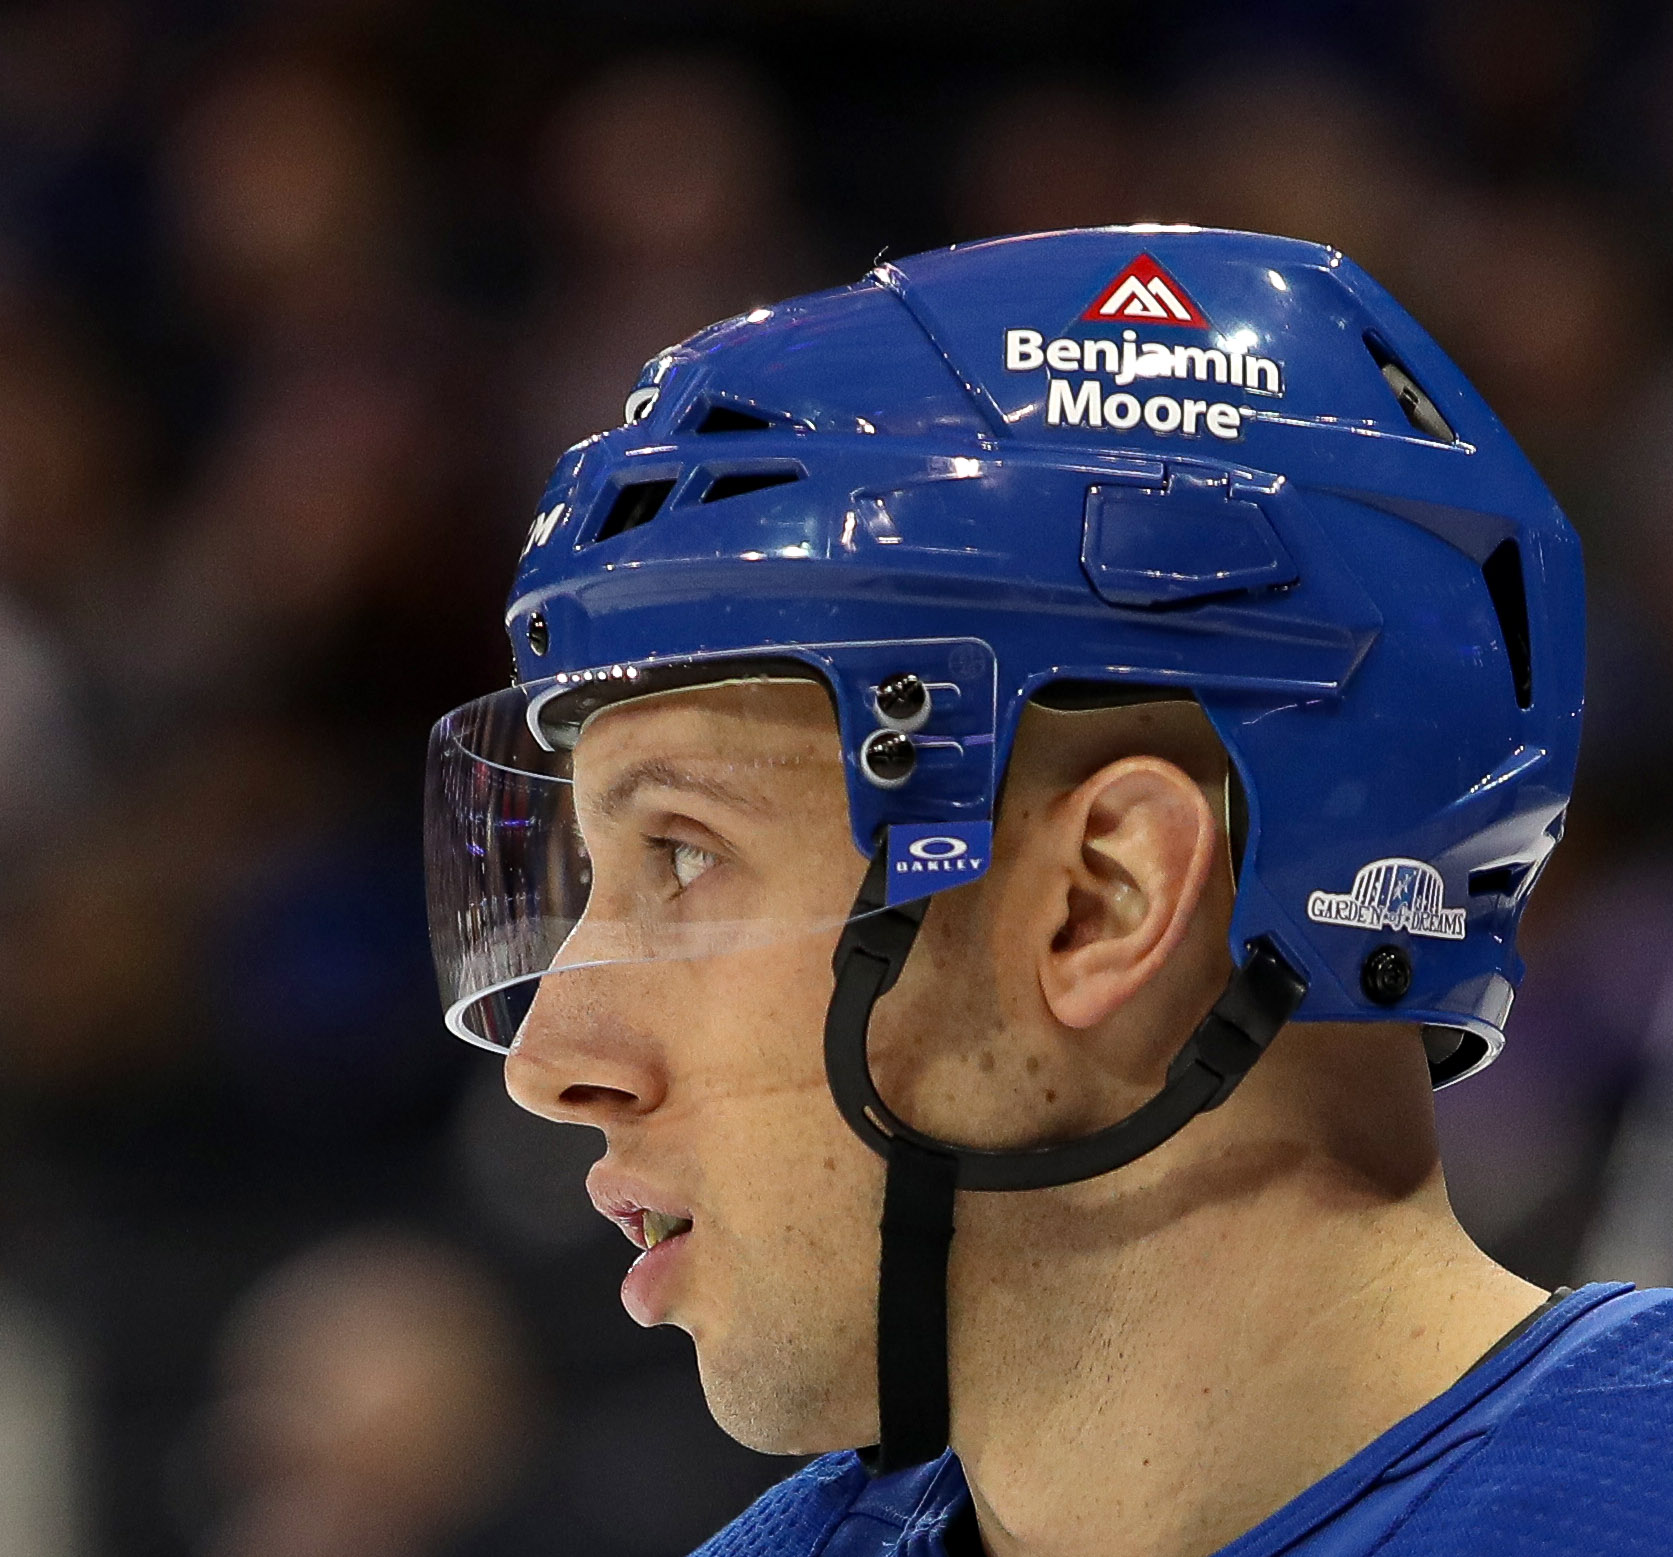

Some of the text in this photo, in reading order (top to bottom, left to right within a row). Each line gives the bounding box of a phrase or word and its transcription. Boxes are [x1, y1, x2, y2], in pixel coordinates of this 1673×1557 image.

[1006, 329, 1281, 393] Benjamin
[1045, 378, 1243, 440] Moore
[896, 859, 982, 872] OAKLEY
[1312, 897, 1384, 925] GARDEN
[1412, 911, 1464, 935] DREAMS
